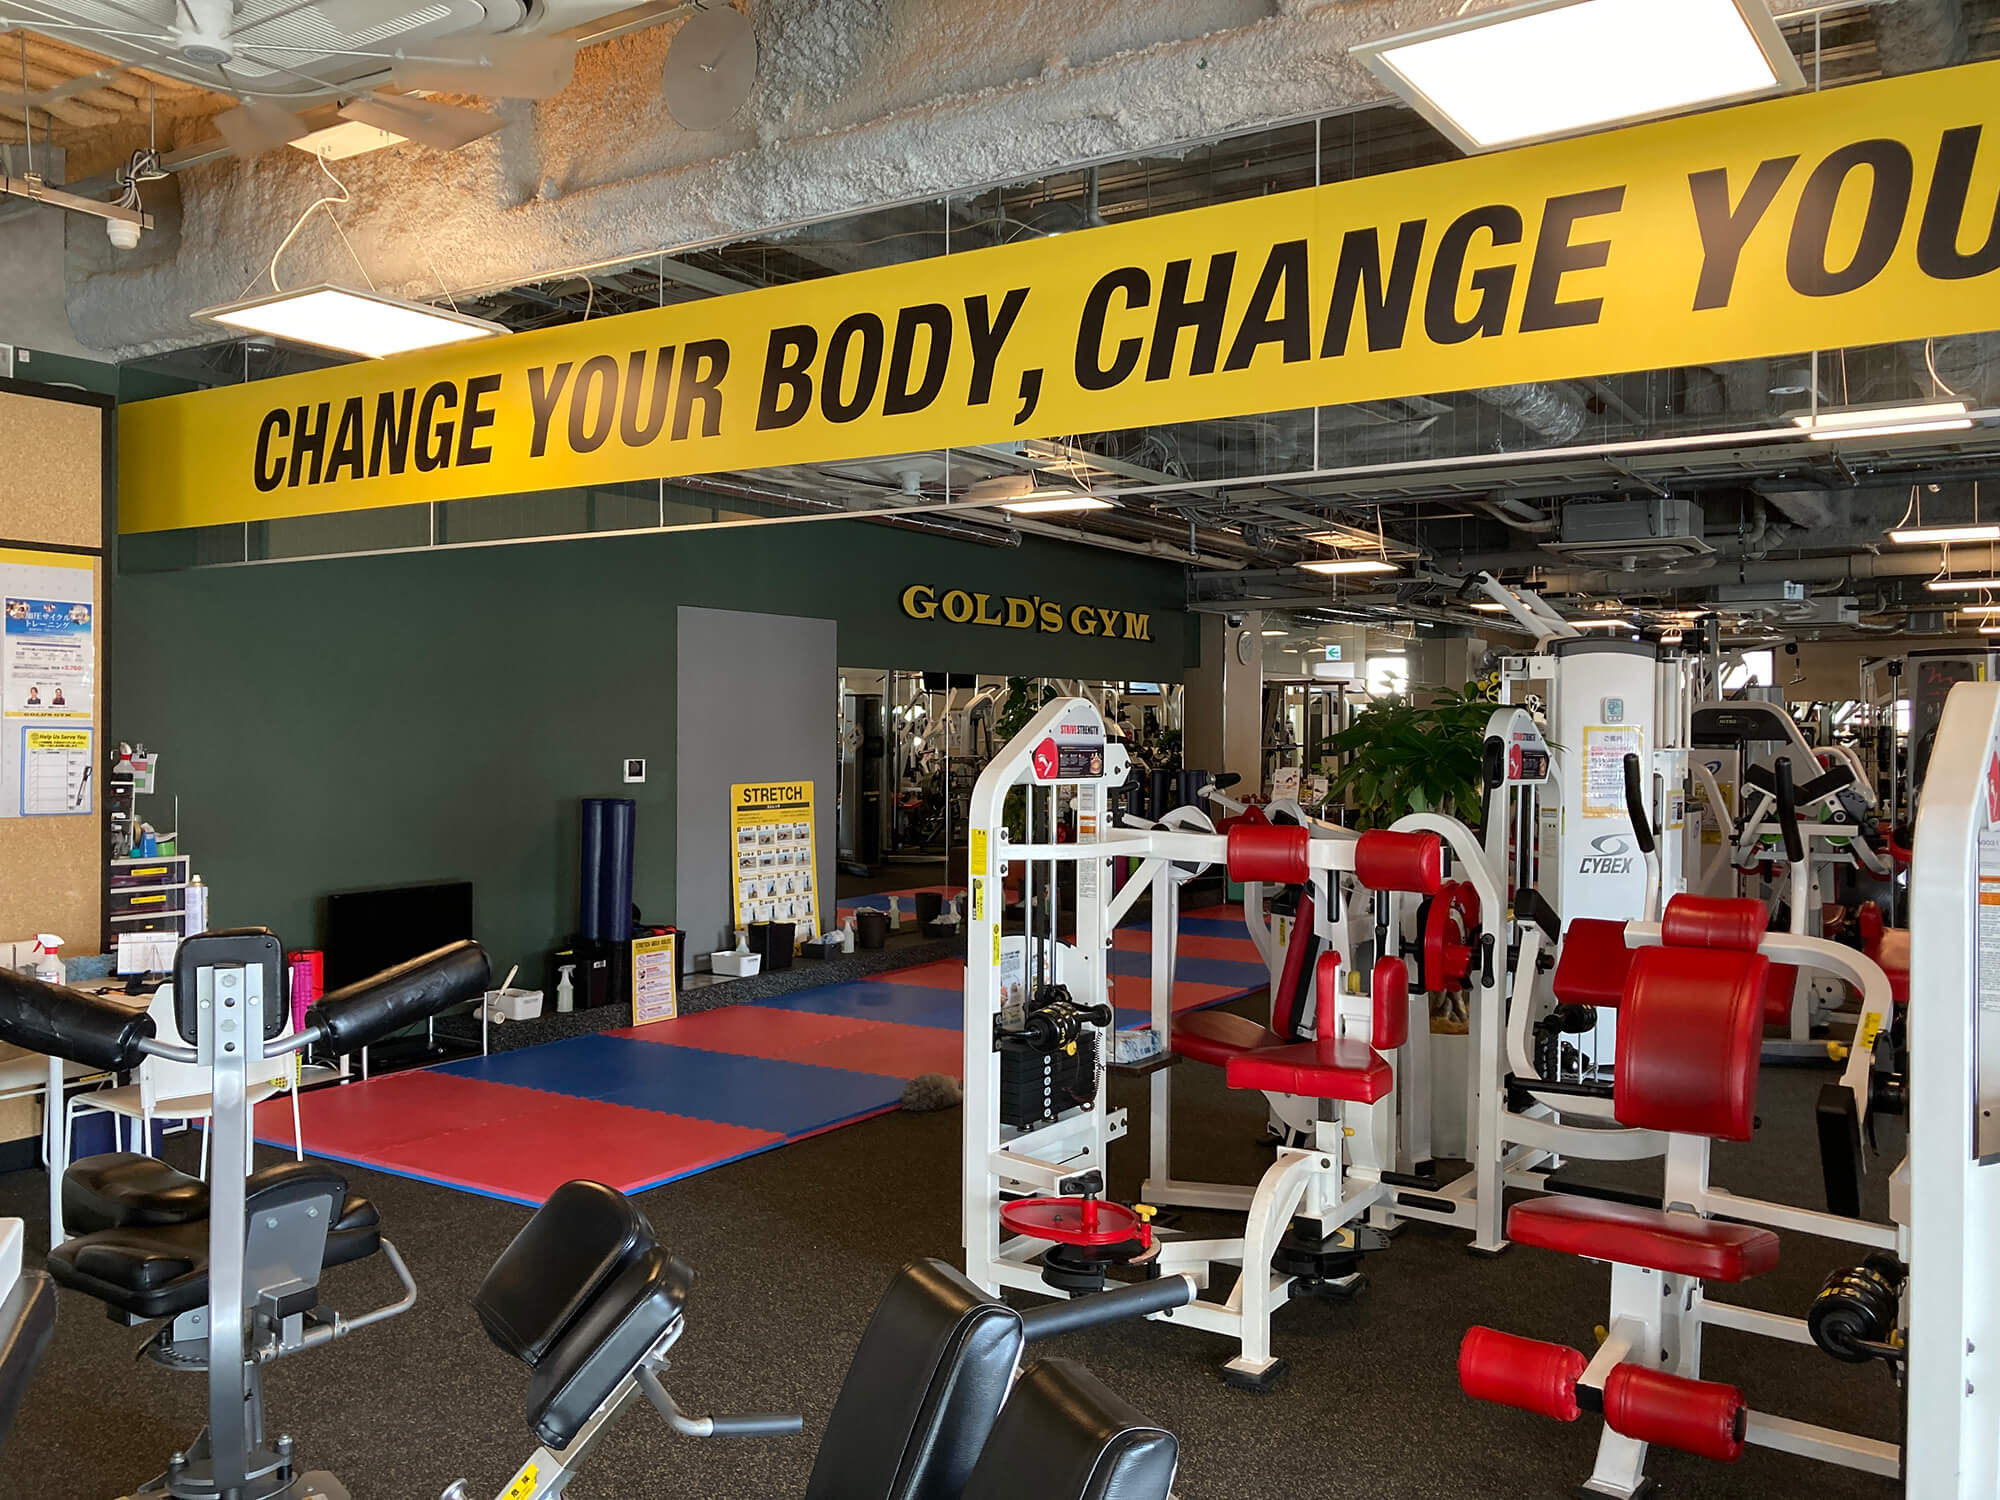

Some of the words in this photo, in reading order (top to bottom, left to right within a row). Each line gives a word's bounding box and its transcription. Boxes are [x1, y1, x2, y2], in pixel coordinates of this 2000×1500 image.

[255, 373, 502, 493] CHANGE
[527, 338, 730, 458] YOUR
[756, 287, 1043, 432] BODY,
[1074, 185, 1627, 391] CHANGE
[1687, 123, 2000, 312] YOU
[901, 584, 1064, 633] GOLD'S
[1070, 605, 1151, 641] GYM
[743, 786, 803, 803] STRETCH
[1579, 857, 1634, 874] CYBEX
